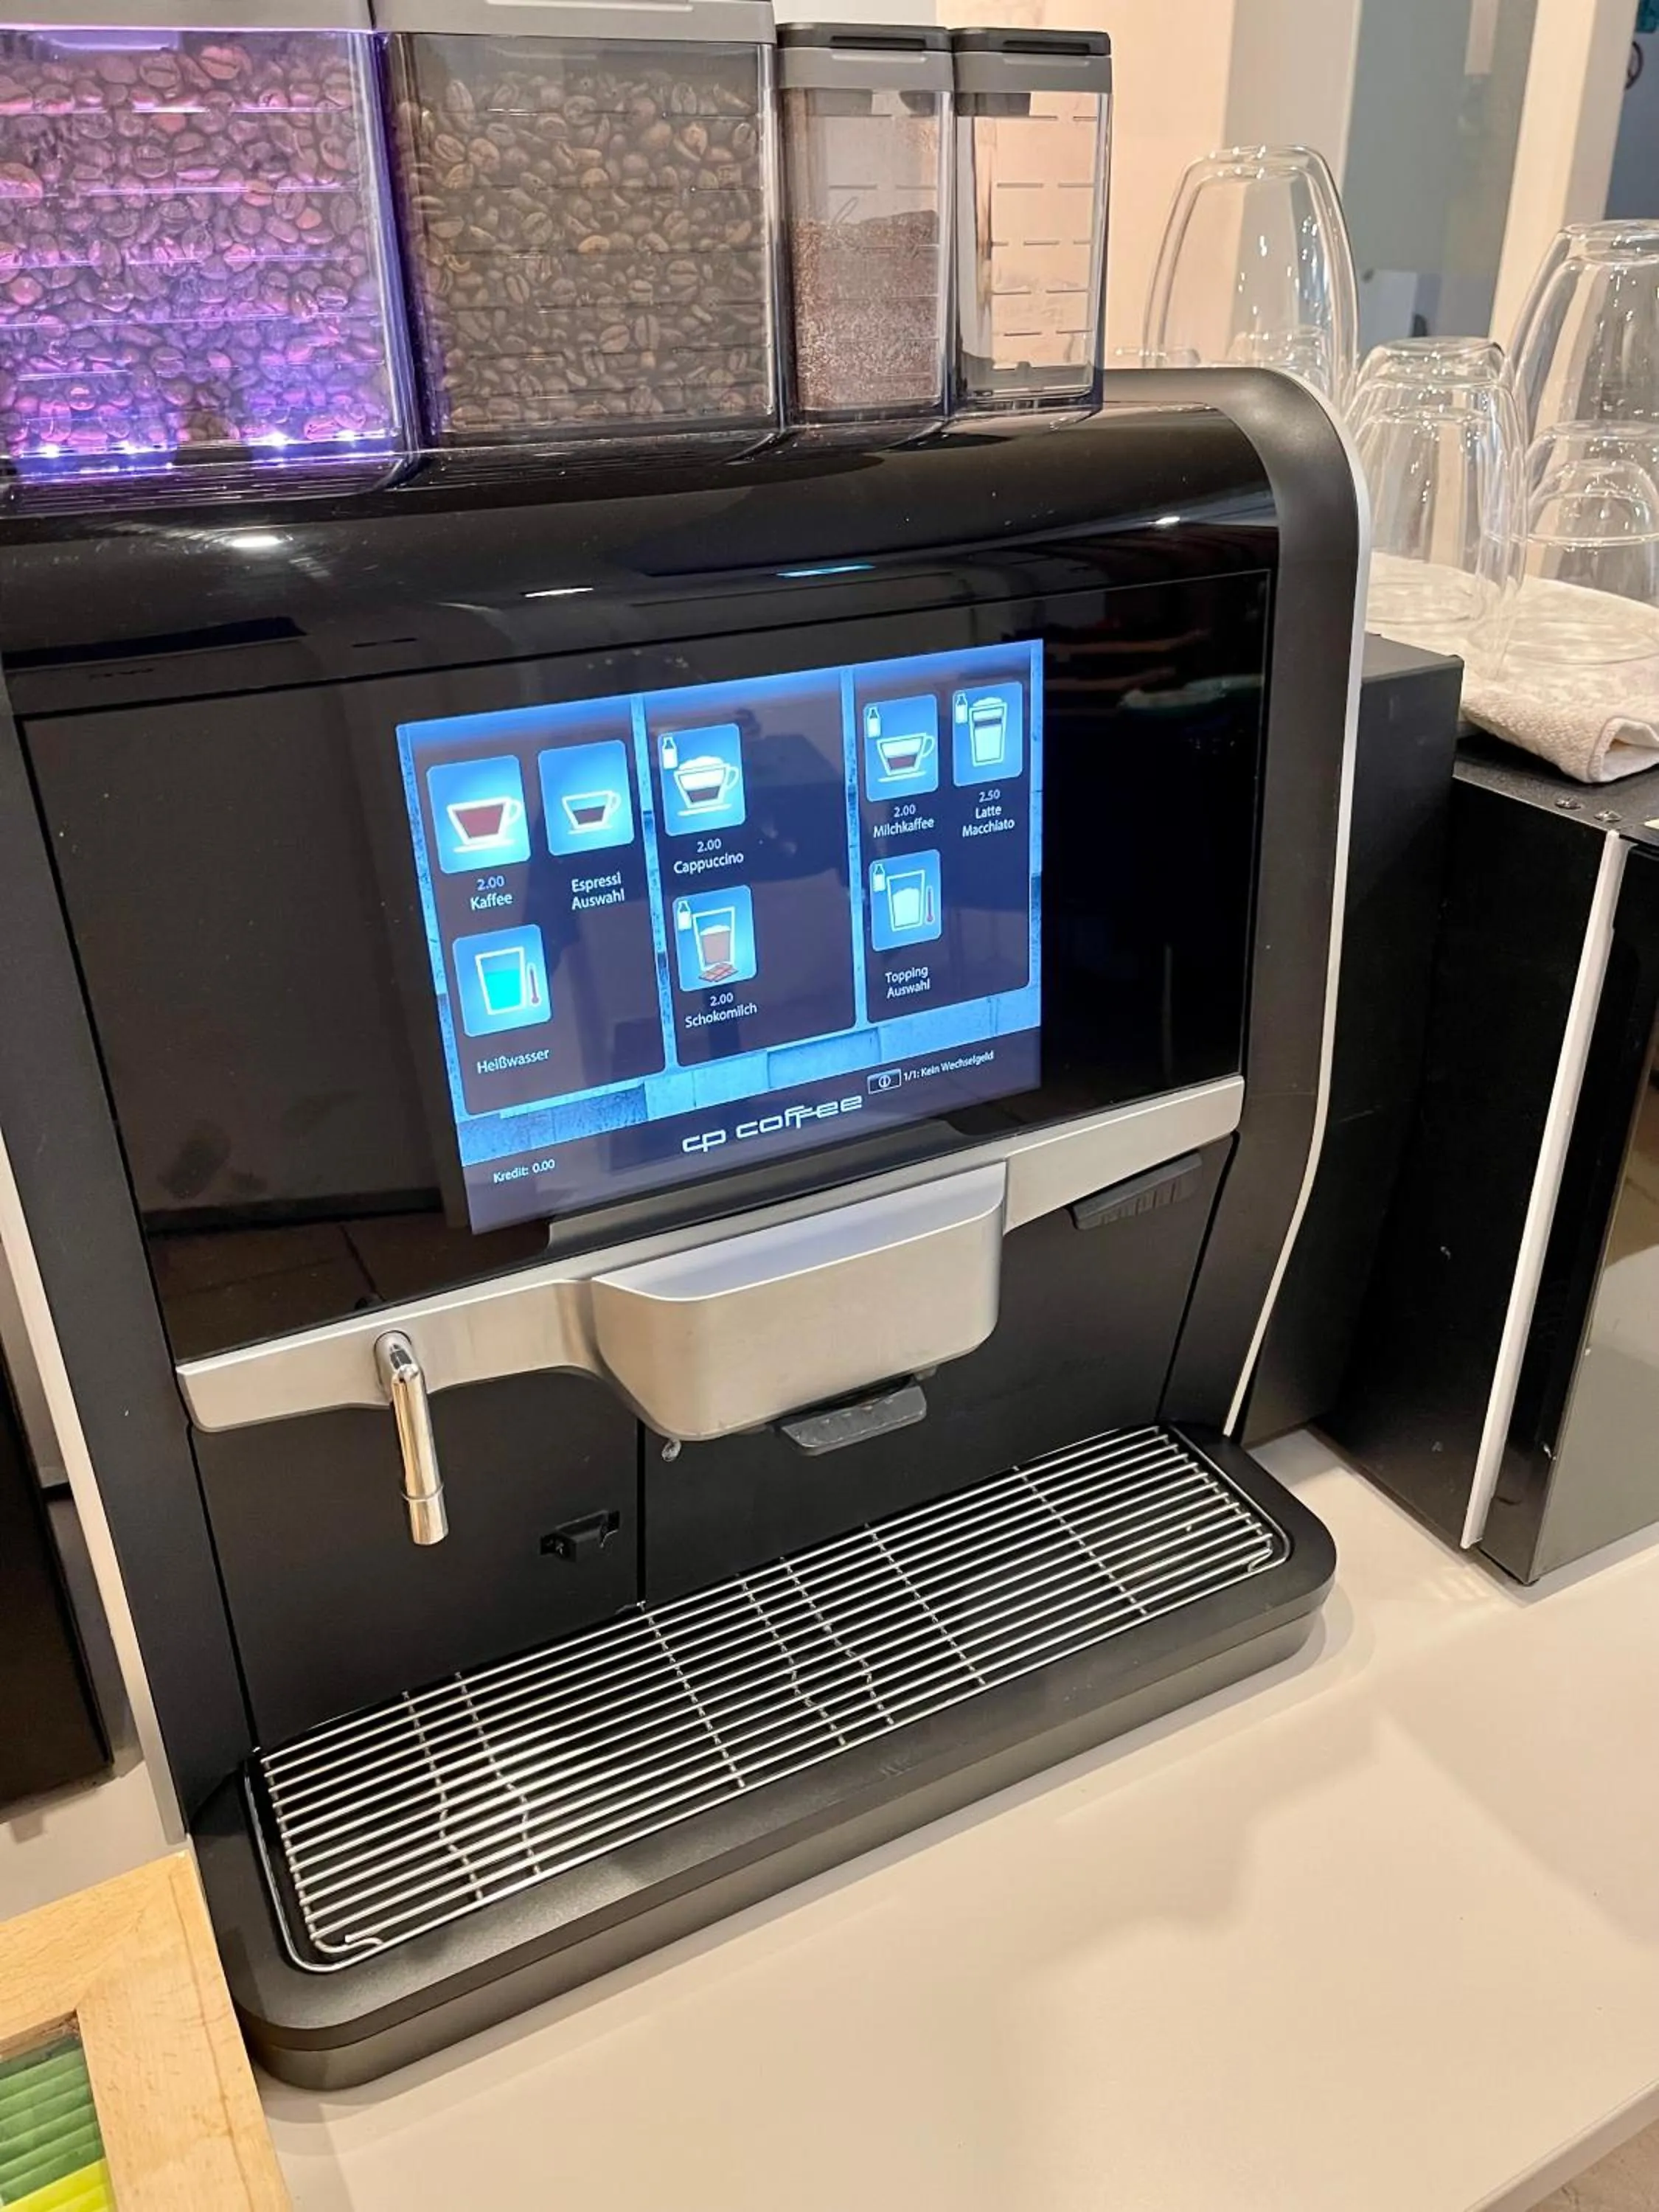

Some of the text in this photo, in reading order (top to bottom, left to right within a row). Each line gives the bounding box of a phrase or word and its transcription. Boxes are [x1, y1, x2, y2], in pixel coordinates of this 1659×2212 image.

[979, 790, 1000, 802] 2.50
[894, 804, 916, 818] 2.00
[975, 805, 1002, 819] Latte
[874, 817, 934, 838] Milchkaffee
[962, 818, 1015, 837] Macchiato
[697, 838, 722, 853] 2.00
[673, 852, 744, 874] Cappuccino
[476, 875, 504, 891] 2.00
[571, 871, 622, 893] Espressi
[470, 893, 513, 911] Kaffee
[571, 888, 625, 910] Auswahl
[885, 967, 928, 984] Topping
[887, 978, 931, 998] Auswahl
[711, 992, 733, 1006] 2.00
[685, 1003, 757, 1029] Schokomilch
[477, 1050, 549, 1074] Heißwasser
[921, 1065, 940, 1077] Kein
[940, 1052, 994, 1071] Wechselgeld
[682, 1095, 863, 1152] cp coffee
[494, 1159, 554, 1183] Kredit: 0.00
